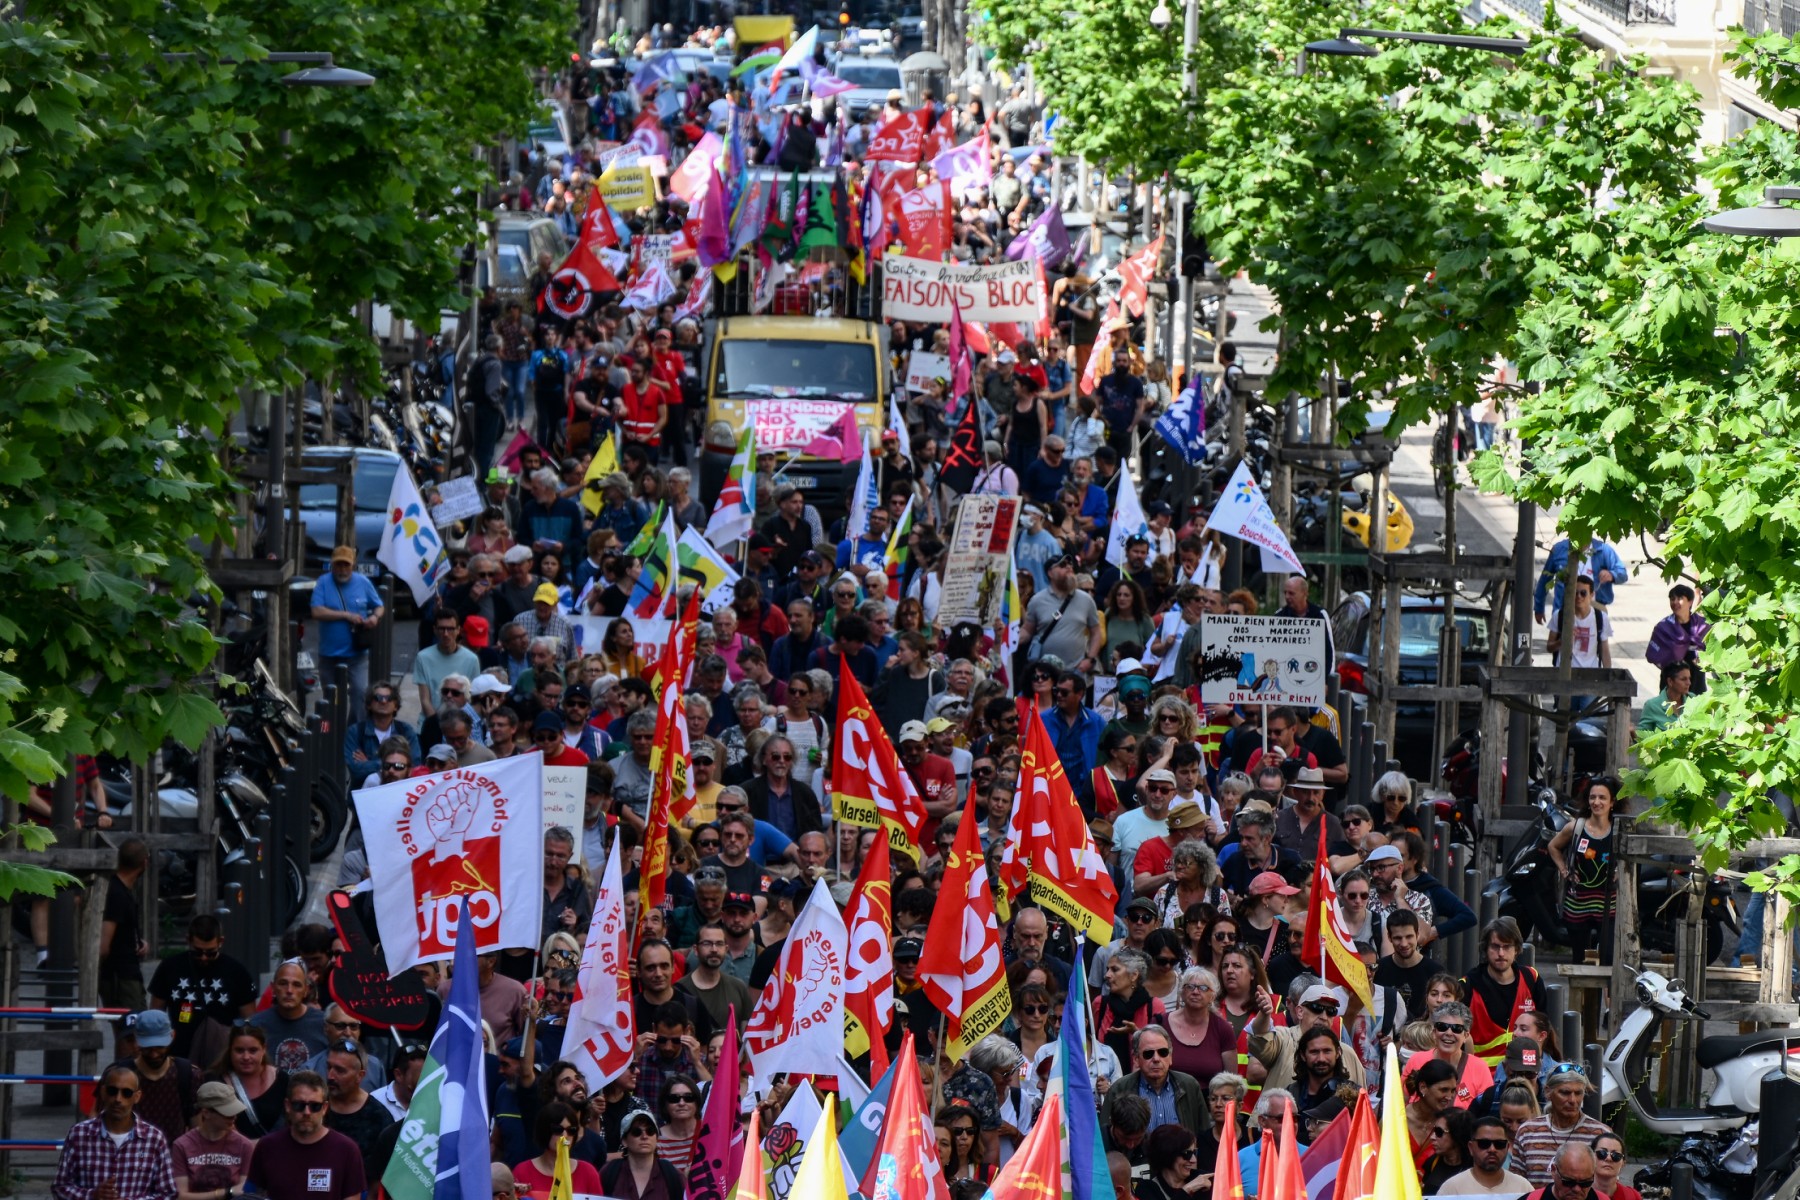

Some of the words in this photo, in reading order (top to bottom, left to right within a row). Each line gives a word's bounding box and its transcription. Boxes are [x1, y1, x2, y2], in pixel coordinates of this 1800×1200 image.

[987, 281, 1035, 308] BLOC
[756, 414, 797, 426] NOS
[1229, 692, 1244, 702] ON
[926, 783, 941, 794] cgt
[1082, 914, 1093, 929] 13
[1523, 1054, 1536, 1062] cgt
[1458, 1087, 1469, 1097] cgt
[188, 1155, 206, 1166] SPACE
[401, 1151, 432, 1188] Nationale
